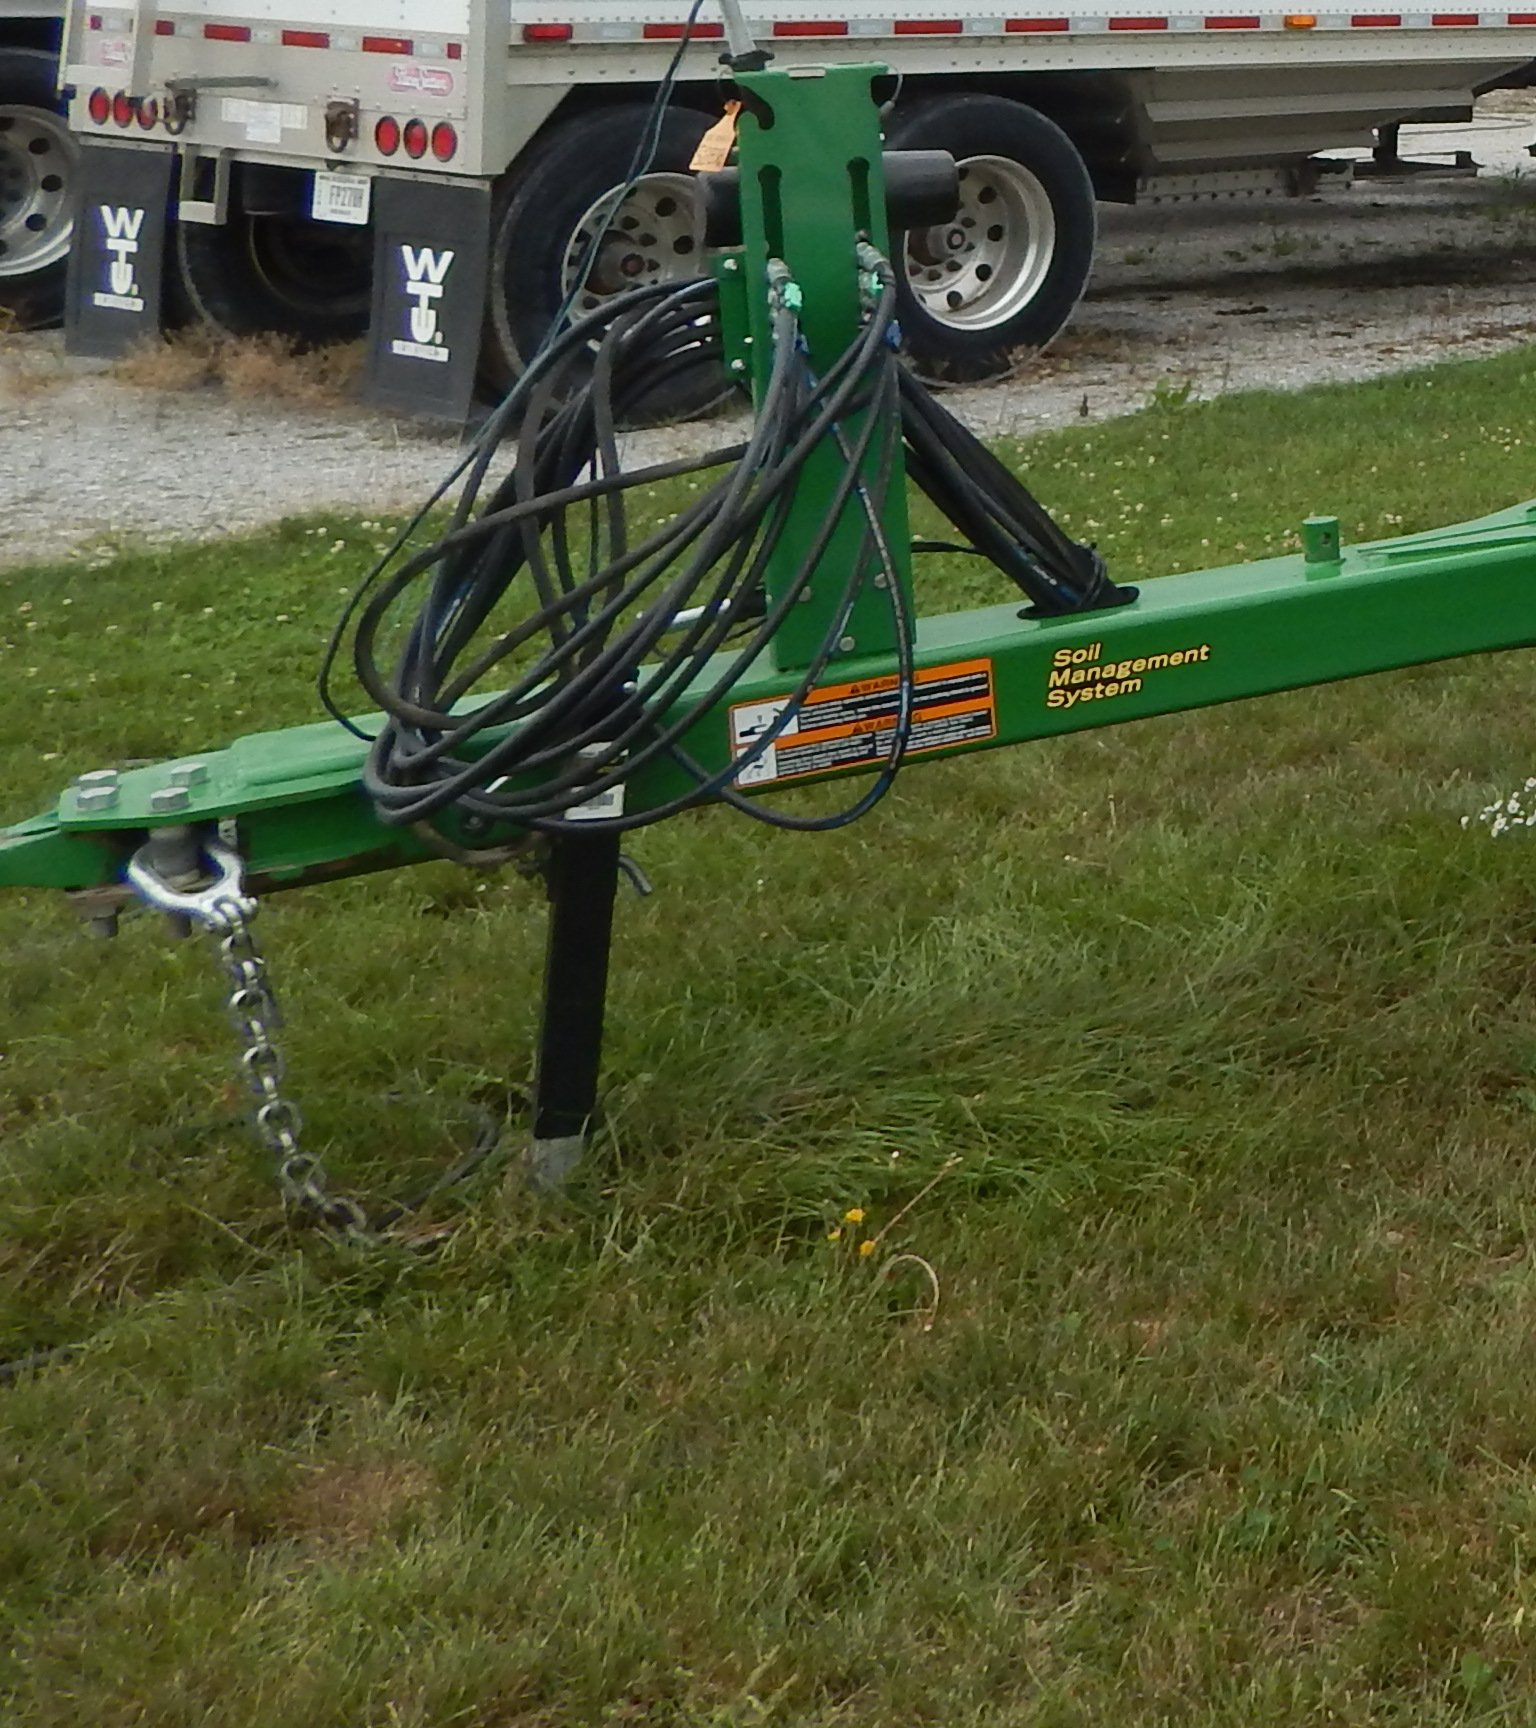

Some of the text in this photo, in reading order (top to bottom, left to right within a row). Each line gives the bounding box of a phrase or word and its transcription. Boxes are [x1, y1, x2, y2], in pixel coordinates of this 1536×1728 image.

[1047, 643, 1212, 689] Management
[1052, 642, 1102, 668] Soil
[1046, 678, 1142, 709] System
